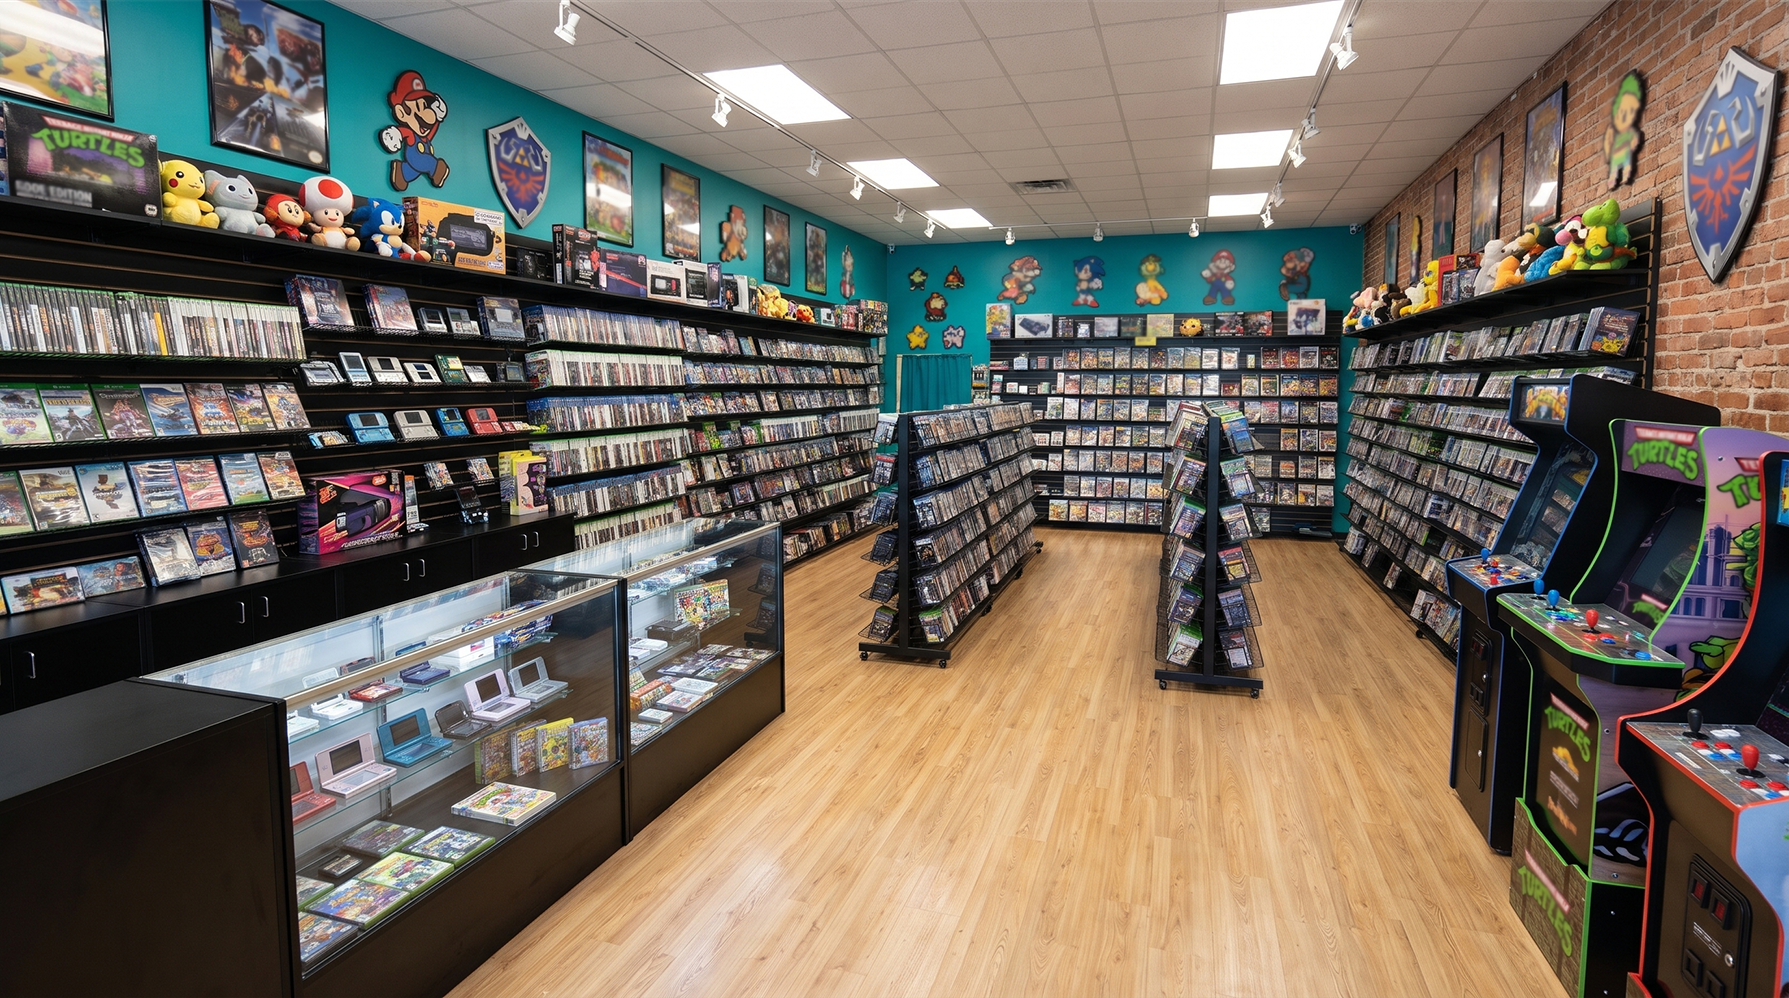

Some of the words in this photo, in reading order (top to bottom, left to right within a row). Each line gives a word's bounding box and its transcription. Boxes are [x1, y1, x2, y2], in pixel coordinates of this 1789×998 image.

[31, 128, 146, 168] TURTLES
[48, 186, 93, 203] EDITION
[1627, 440, 1699, 480] TURTLES
[1544, 706, 1591, 763] TURTLES
[1518, 865, 1573, 957] TURTLES
